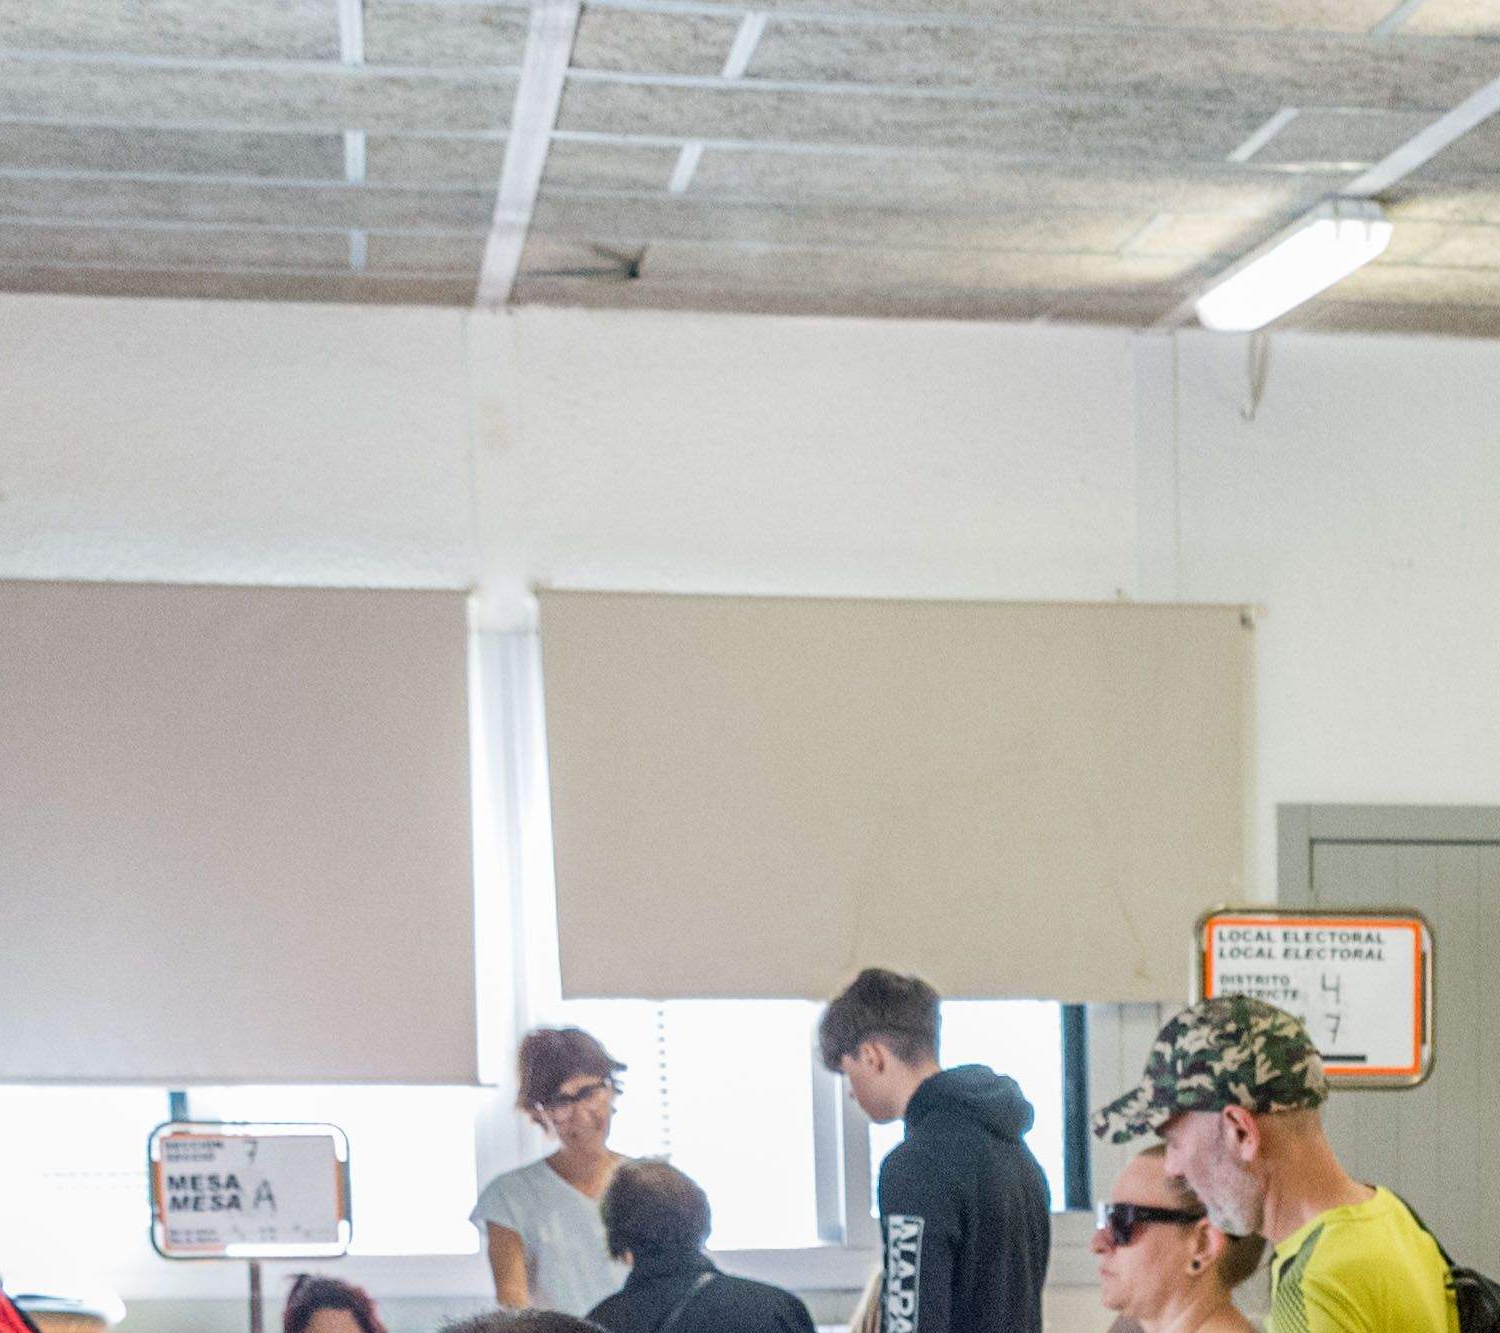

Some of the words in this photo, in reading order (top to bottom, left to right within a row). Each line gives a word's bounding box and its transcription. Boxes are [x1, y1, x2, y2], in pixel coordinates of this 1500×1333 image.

[1218, 930, 1273, 944] LOCAL
[1282, 931, 1386, 945] ELECTORAL
[1218, 947, 1275, 961] LOCAL
[1282, 947, 1386, 962] ELECTORAL
[1320, 972, 1341, 1005] 4
[167, 1173, 242, 1192] MESA
[169, 1194, 243, 1213] MESA
[252, 1178, 278, 1212] A
